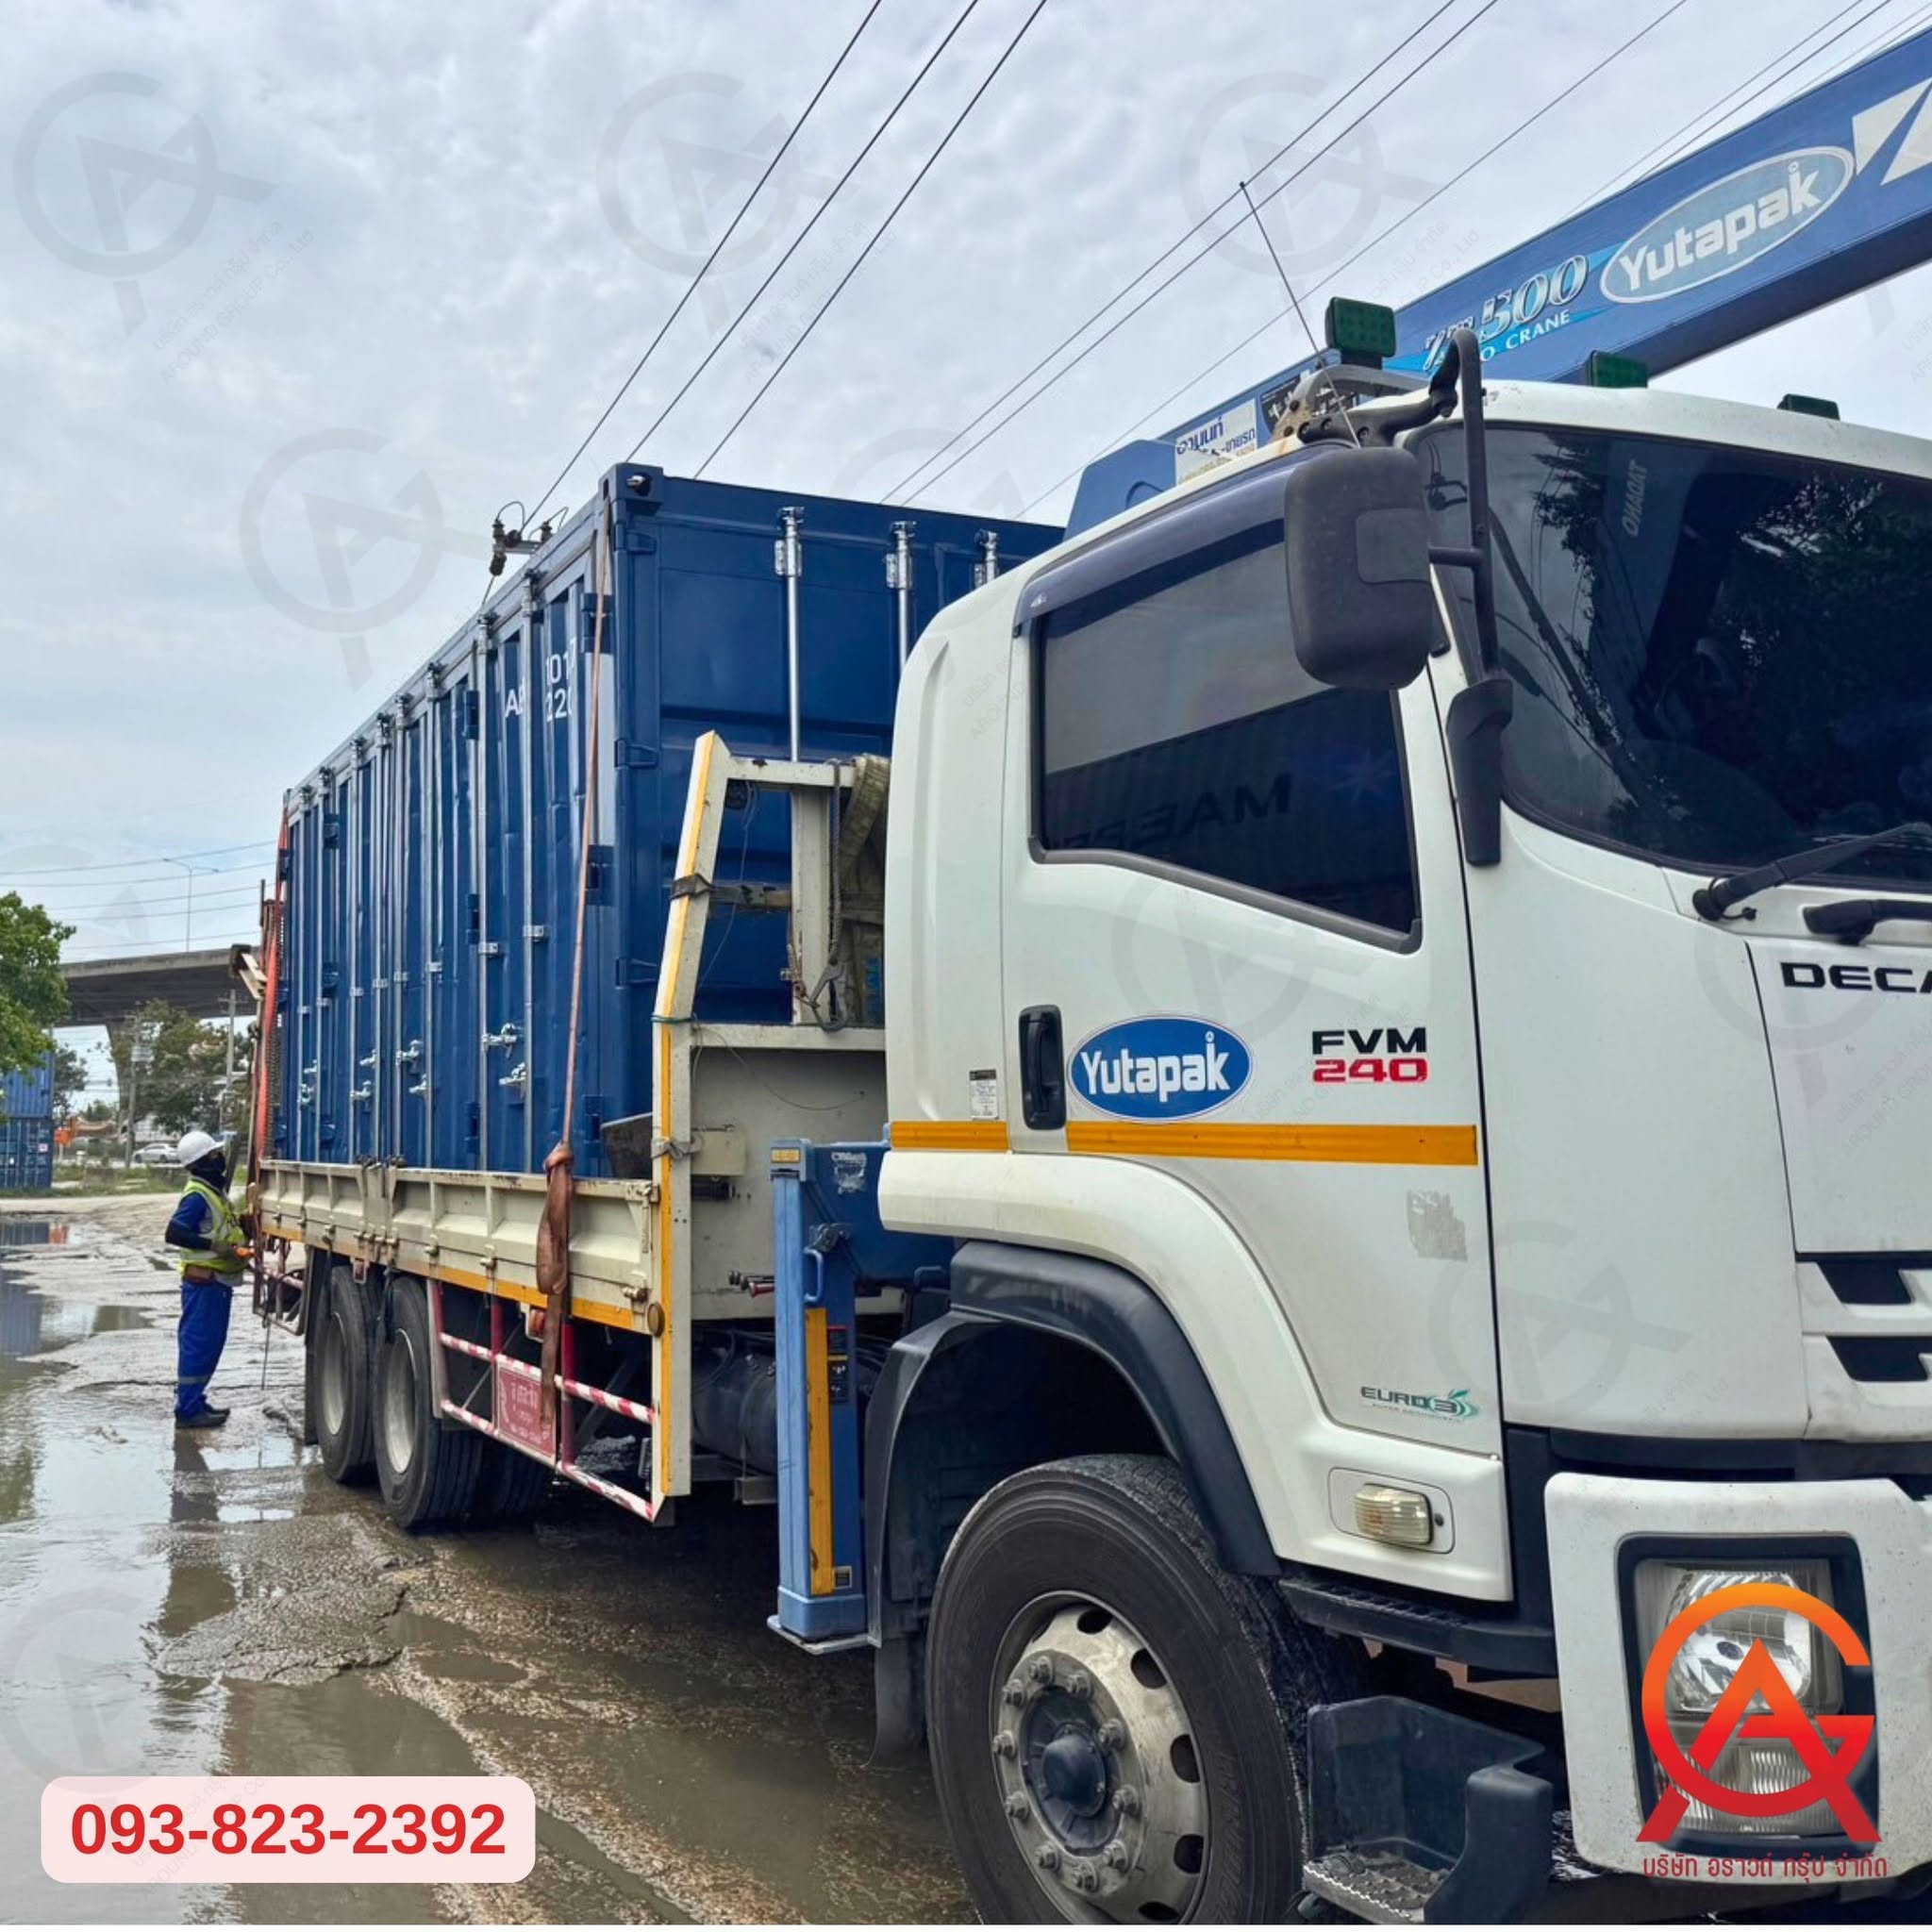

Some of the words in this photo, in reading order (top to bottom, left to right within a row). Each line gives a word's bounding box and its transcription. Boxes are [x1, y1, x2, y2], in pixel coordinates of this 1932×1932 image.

[1619, 162, 1822, 291] Yutapak
[1507, 309, 1571, 350] CRANE
[1312, 1026, 1426, 1055] FVM
[1080, 1031, 1230, 1103] Yutapak
[1313, 1058, 1428, 1083] 240
